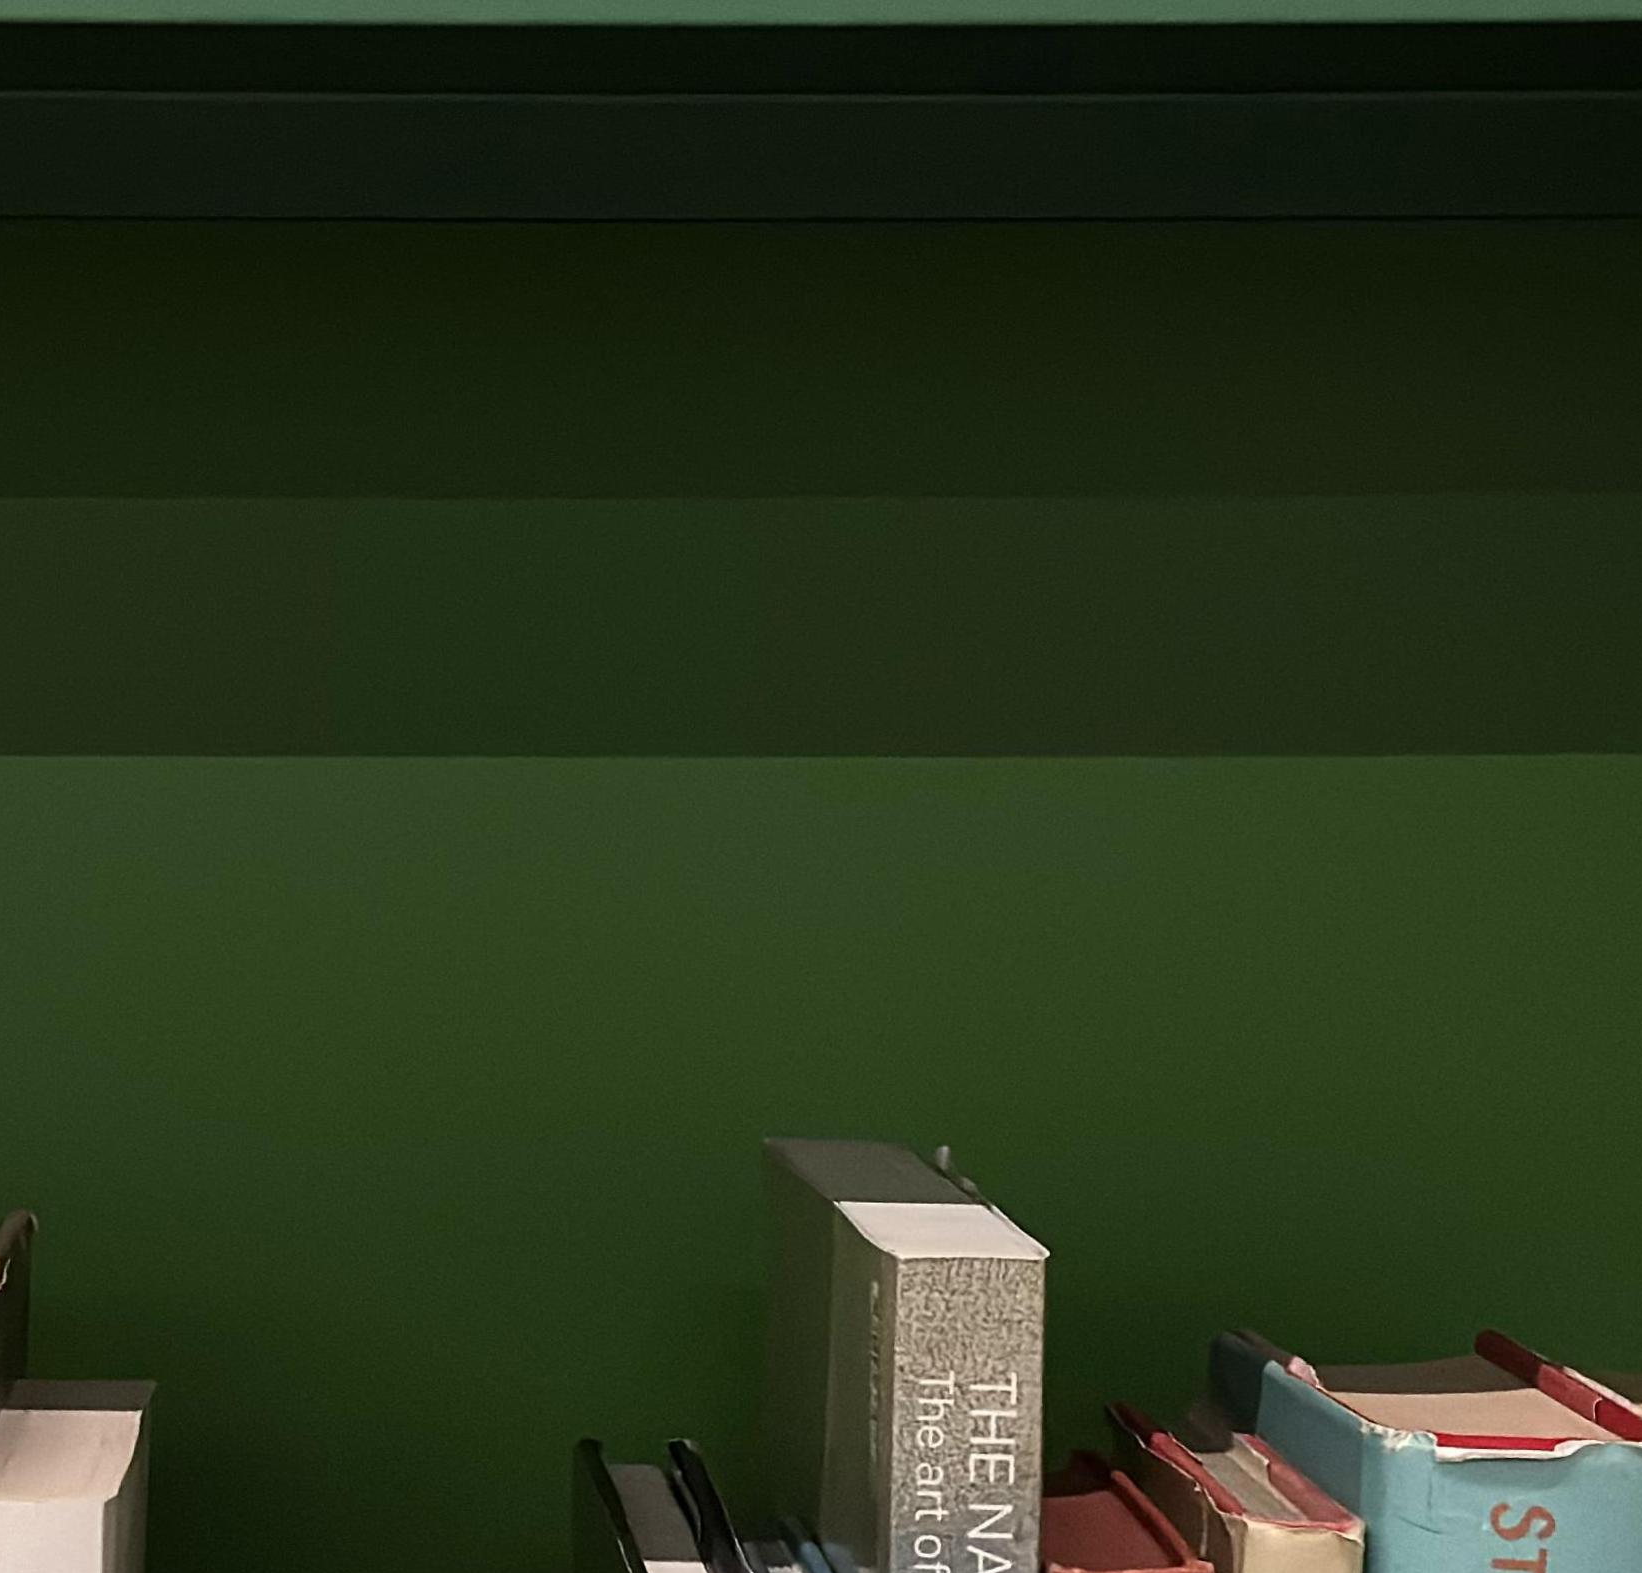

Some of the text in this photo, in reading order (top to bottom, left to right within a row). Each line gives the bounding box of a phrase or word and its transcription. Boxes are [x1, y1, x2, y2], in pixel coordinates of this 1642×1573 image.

[916, 1370, 955, 1450] The
[968, 1372, 1017, 1485] THE
[915, 1462, 950, 1522] art
